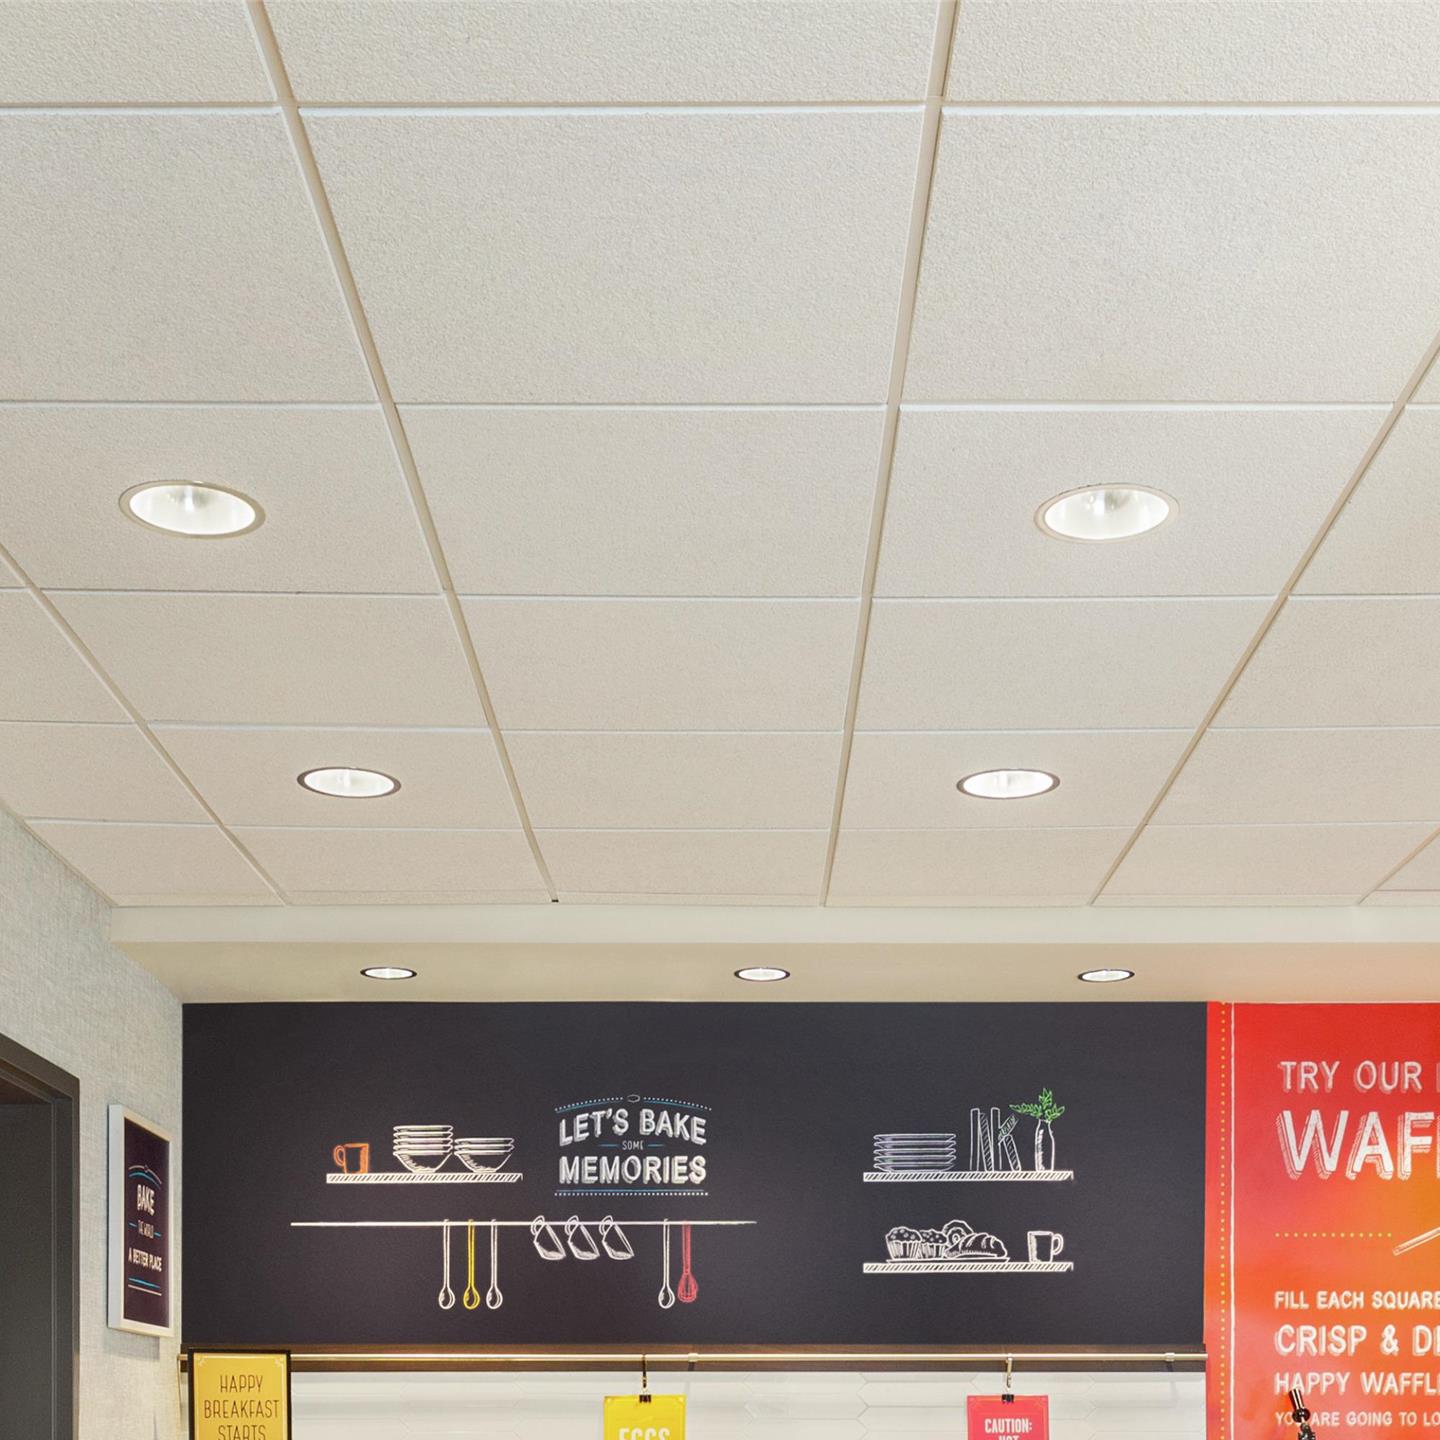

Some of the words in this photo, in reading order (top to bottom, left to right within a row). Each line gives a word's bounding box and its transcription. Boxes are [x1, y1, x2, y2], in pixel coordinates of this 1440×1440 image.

[1278, 1060, 1340, 1094] TRY
[1353, 1060, 1423, 1094] OUR
[559, 1108, 629, 1147] LET'S
[639, 1108, 707, 1146] BAKE
[622, 1140, 644, 1151] SOME
[559, 1155, 707, 1185] MEMORIES
[137, 1184, 155, 1216] BAKE
[1274, 1290, 1310, 1311] FILL
[1316, 1290, 1365, 1311] EACH
[1274, 1324, 1368, 1356] CRISP
[1379, 1324, 1399, 1356] &
[220, 1374, 263, 1393] HAPPY
[1274, 1371, 1351, 1396] HAPPY
[204, 1399, 280, 1419] BREAKFAST
[1275, 1411, 1305, 1426] YO
[1310, 1411, 1340, 1427] ARE
[1345, 1411, 1393, 1427] GOING
[1399, 1411, 1418, 1427] TO
[984, 1418, 1033, 1434] CAUTION:
